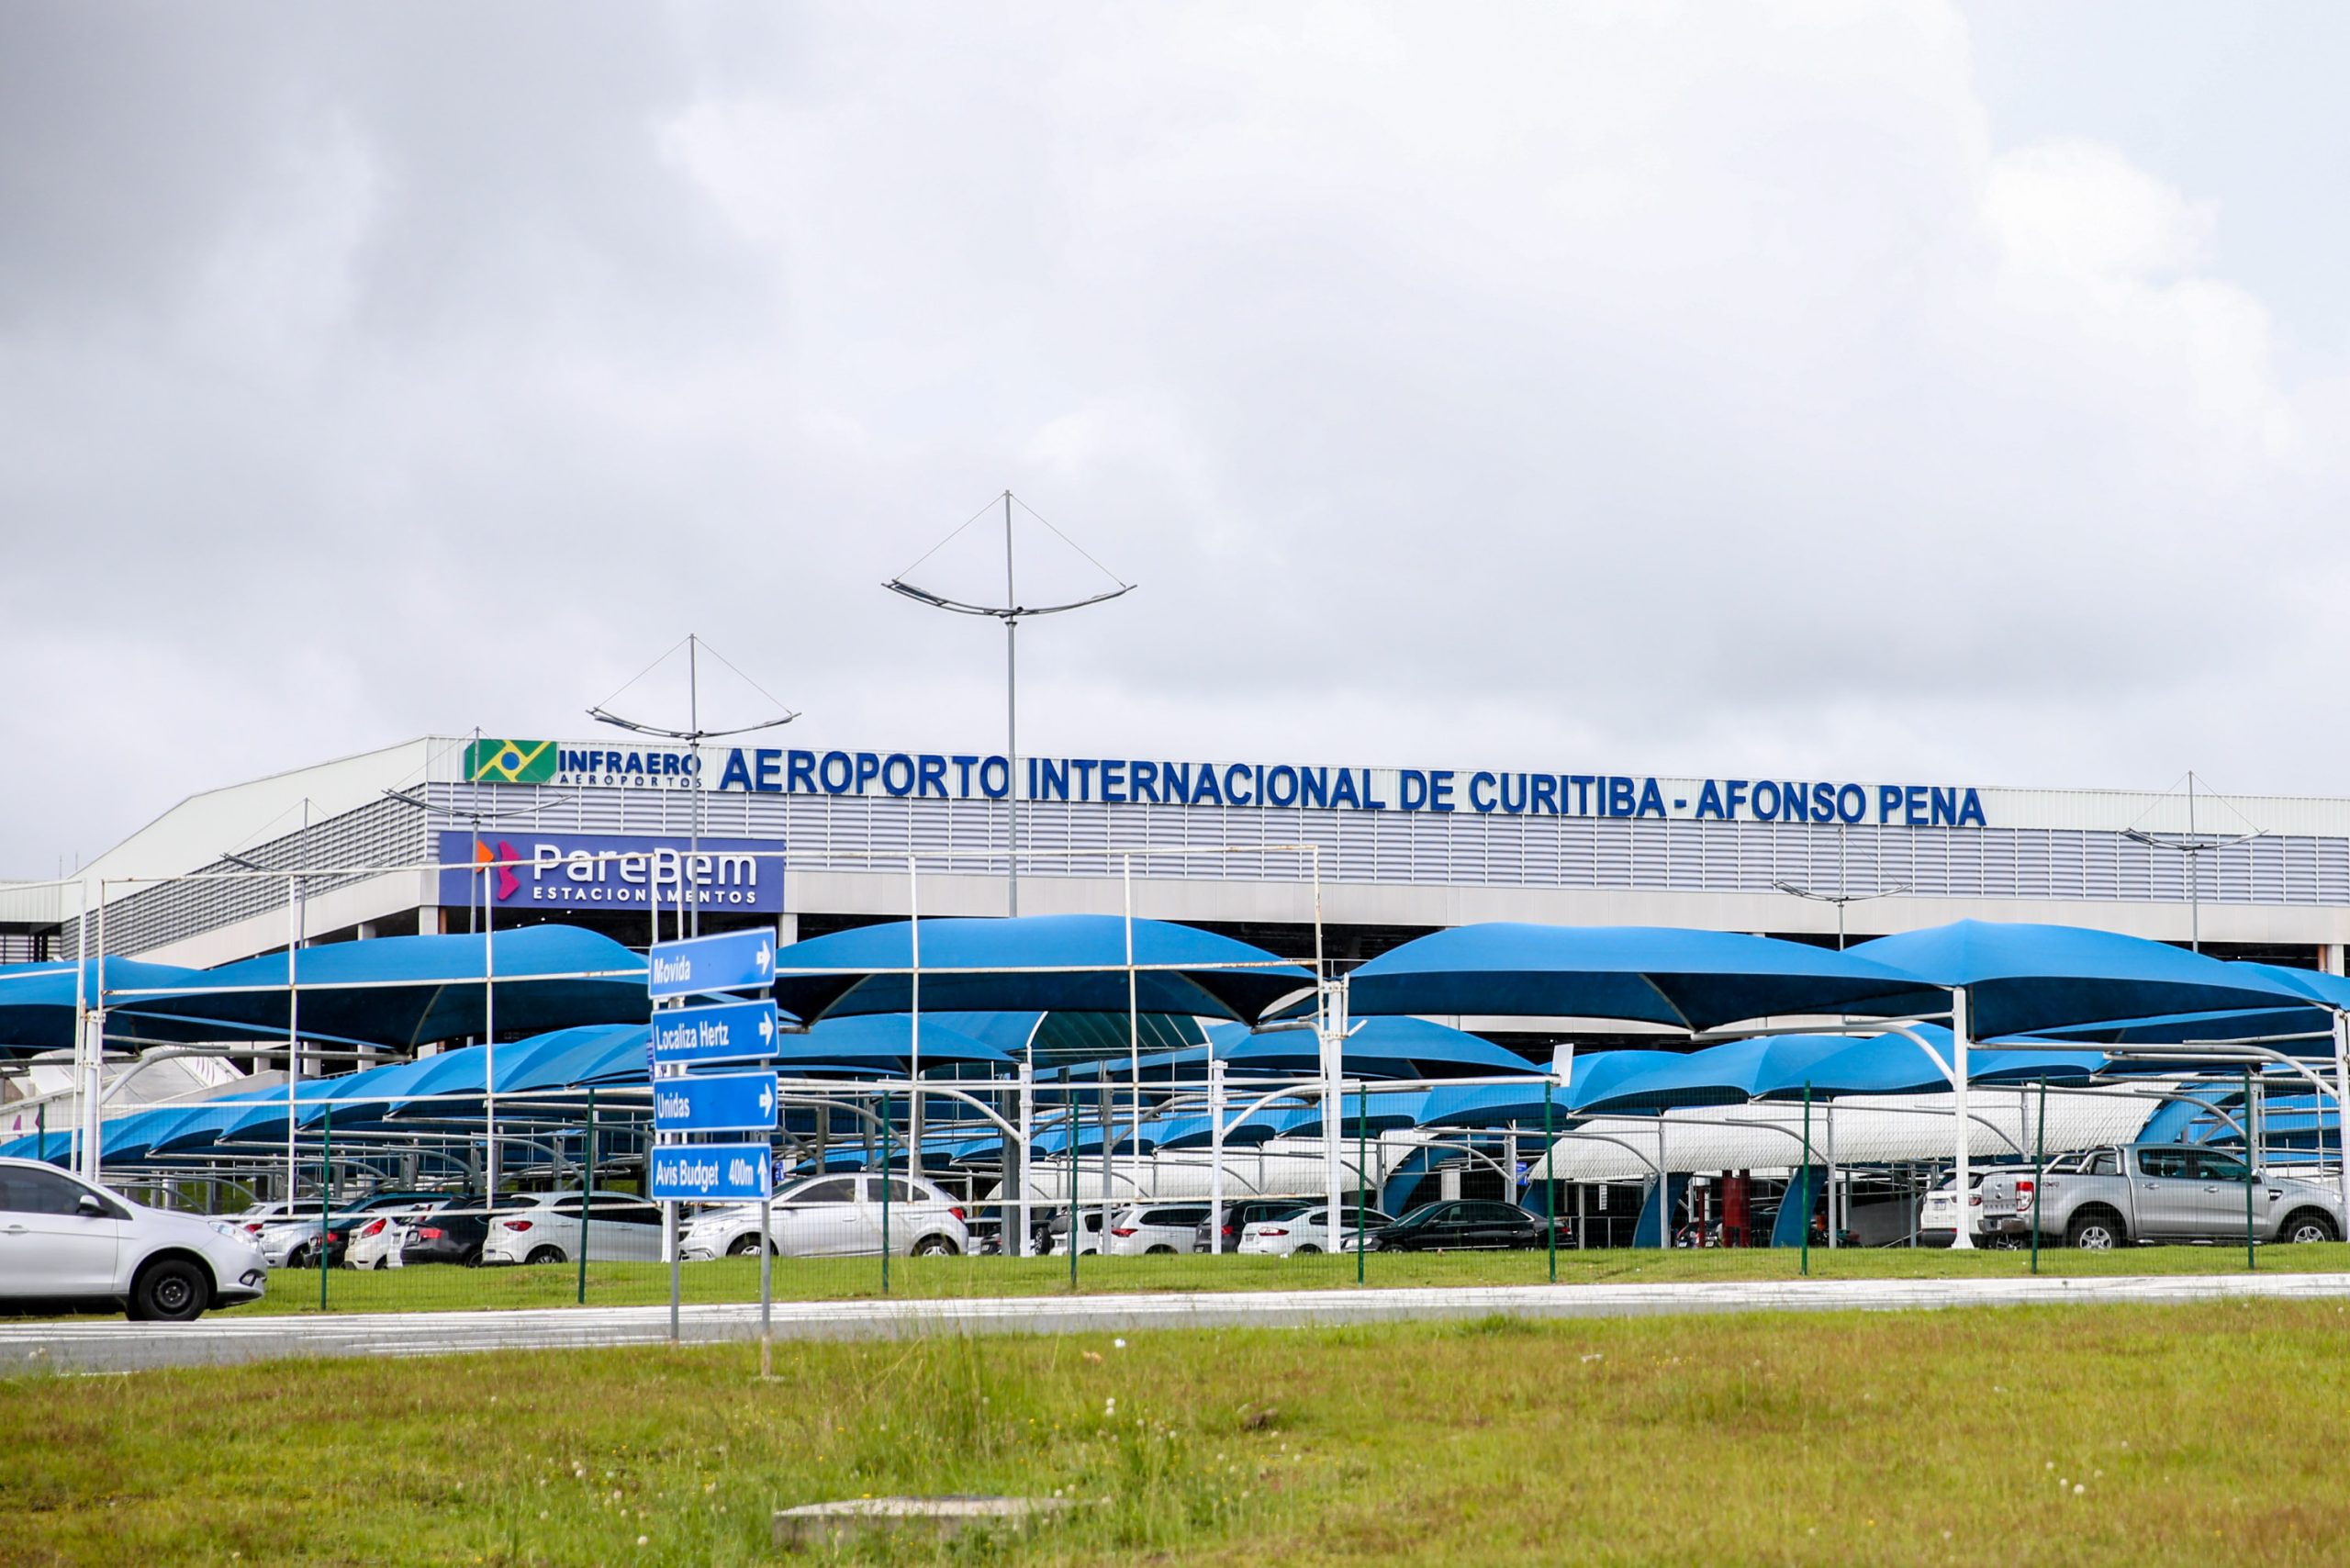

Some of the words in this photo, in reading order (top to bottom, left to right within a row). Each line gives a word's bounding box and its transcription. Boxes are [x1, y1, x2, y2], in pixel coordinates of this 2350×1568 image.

[559, 750, 701, 776] INFRAERO
[559, 774, 702, 789] AEROPORTOS
[719, 747, 1010, 798] AEROPORTO
[1029, 757, 1386, 810] INTERNACIONAL
[1400, 769, 1455, 812] DE
[1469, 771, 1667, 817] CURITIBA
[1695, 778, 1866, 823] AFONSO
[1878, 785, 1986, 826] PENA
[533, 844, 756, 886] PareBem
[654, 958, 691, 984] Movida
[655, 1025, 698, 1051] Localiza
[699, 1021, 730, 1047] Hertz
[657, 1092, 690, 1119] Unidas
[655, 1160, 678, 1186] Avis
[679, 1159, 720, 1193] Budget
[728, 1159, 754, 1185] 400m
